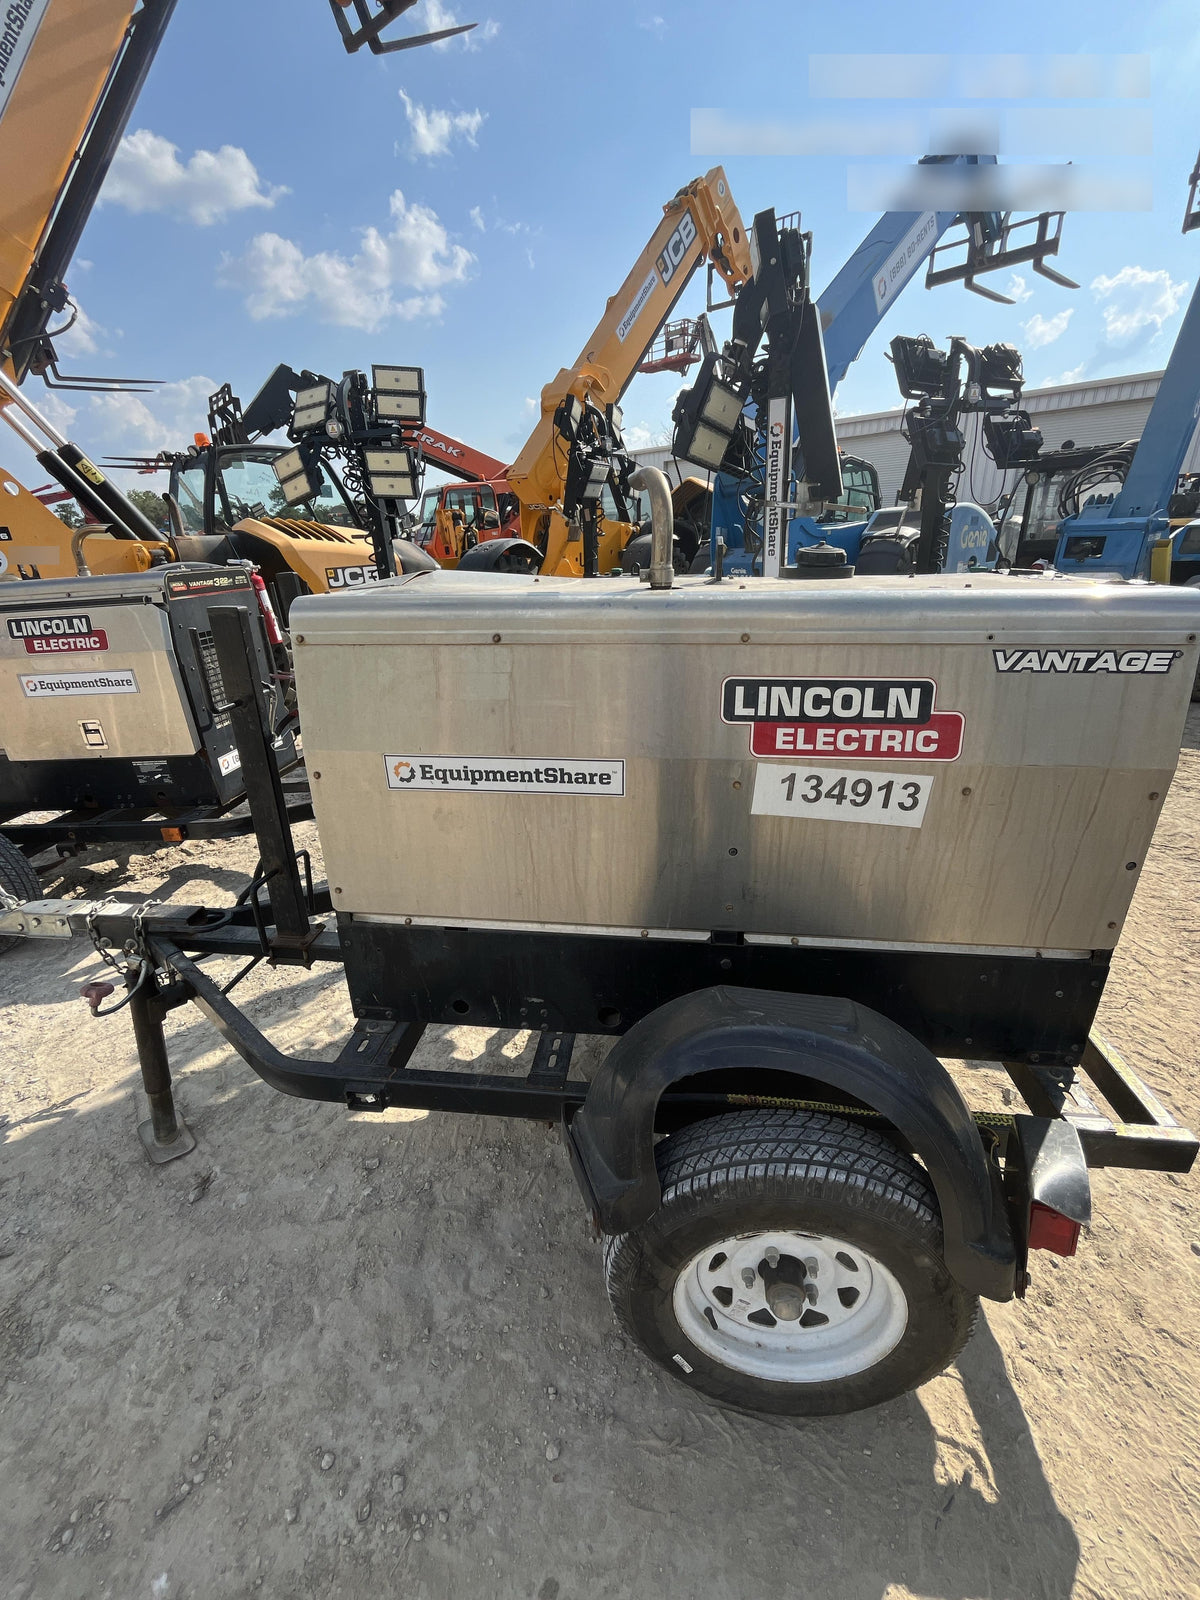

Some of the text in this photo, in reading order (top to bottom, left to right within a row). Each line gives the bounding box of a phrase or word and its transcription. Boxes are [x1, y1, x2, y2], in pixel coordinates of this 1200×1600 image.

[661, 212, 696, 283] JCB
[622, 275, 656, 330] EquipmentShare
[412, 430, 462, 457] TRAK
[961, 525, 988, 549] Genie
[189, 579, 213, 587] VANTAGE
[11, 618, 89, 637] LINCOLN
[33, 636, 101, 651] ELECTRIC
[993, 650, 1177, 673] VANTAGE
[38, 676, 133, 691] EquipmentShare
[734, 686, 921, 718] LINCOLN
[775, 728, 939, 753] ELECTRIC
[419, 764, 612, 786] EquipmentShare
[780, 772, 921, 812] 134913
[779, 1100, 801, 1108] NOT
[804, 1101, 840, 1111] STAND
